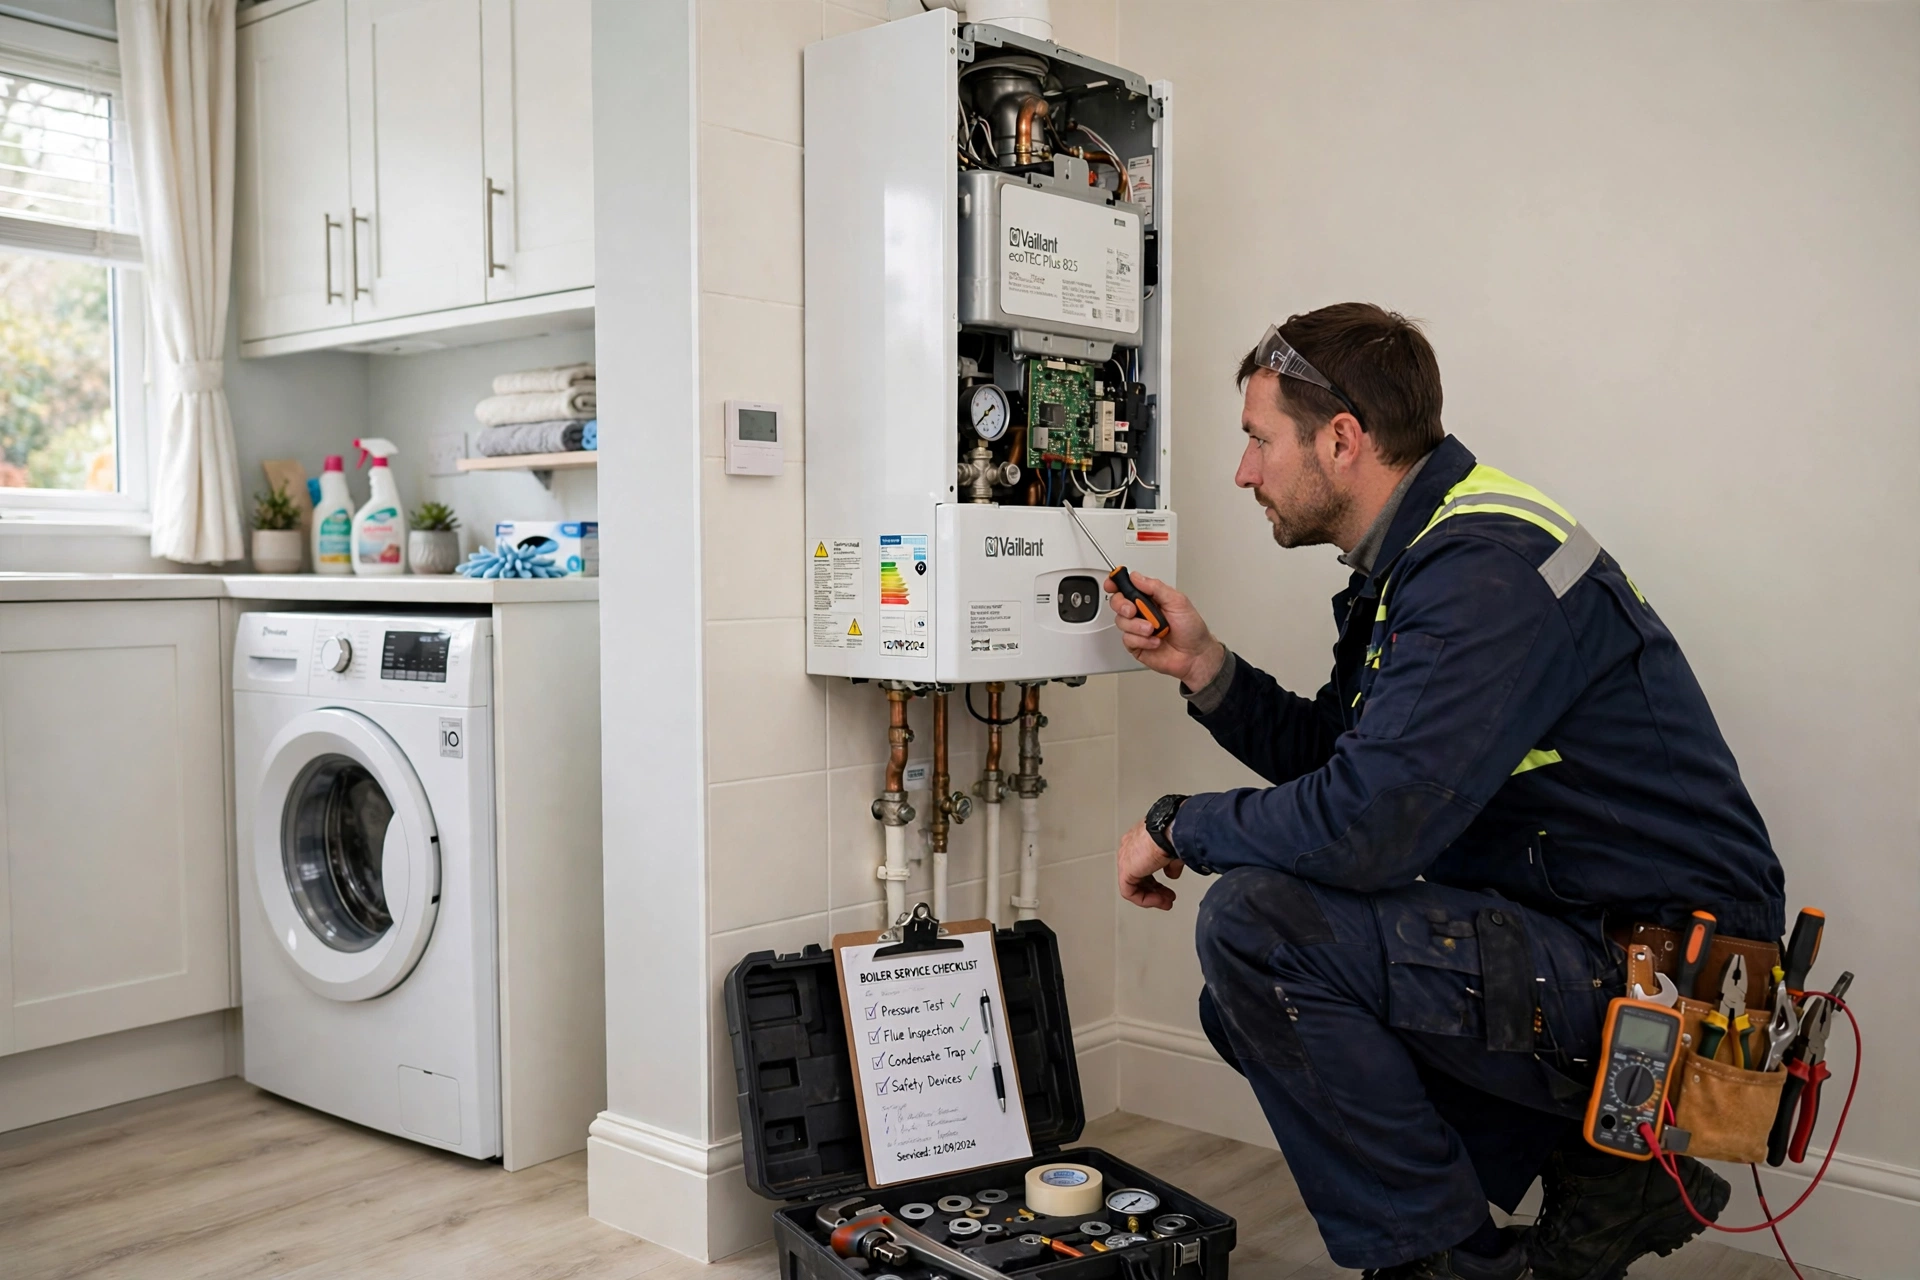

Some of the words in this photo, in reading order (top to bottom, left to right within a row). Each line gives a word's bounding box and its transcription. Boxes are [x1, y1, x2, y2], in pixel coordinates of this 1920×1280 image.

[1021, 229, 1058, 253] Vaillant
[1009, 251, 1042, 266] ecoTEC
[1043, 254, 1061, 269] Plus
[1062, 258, 1079, 272] 825
[999, 536, 1044, 557] Vaillant
[860, 970, 892, 983] BOILER
[894, 965, 931, 979] SERVICE
[932, 960, 978, 974] CHECKLIST
[881, 1005, 921, 1017] Pressure
[923, 998, 945, 1012] Test
[884, 1029, 905, 1042] Flue
[908, 1024, 954, 1042] Inspection
[888, 1051, 941, 1067] Condensate
[944, 1046, 966, 1061] Trap
[892, 1077, 923, 1094] Safety
[927, 1074, 962, 1087] Devices
[897, 1146, 931, 1162] Serviced:
[933, 1139, 977, 1155] 12/09/2024
